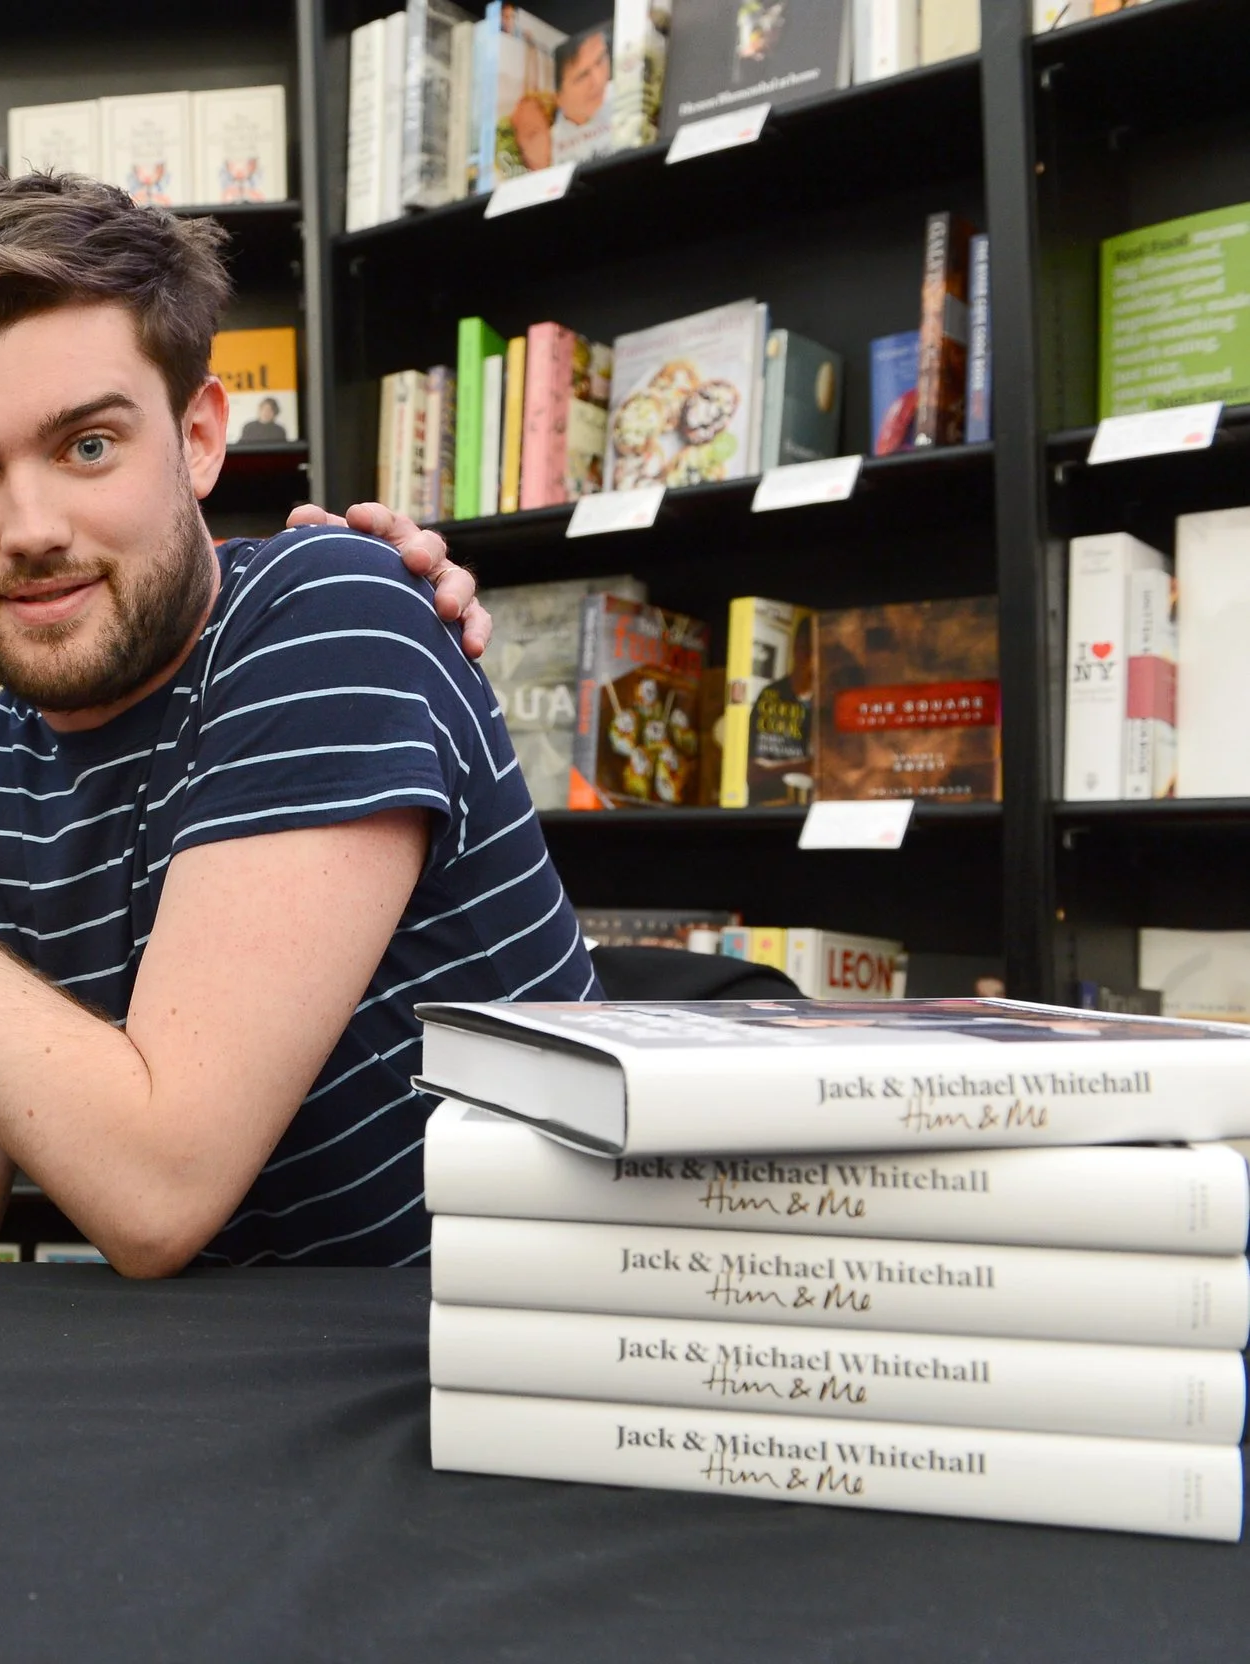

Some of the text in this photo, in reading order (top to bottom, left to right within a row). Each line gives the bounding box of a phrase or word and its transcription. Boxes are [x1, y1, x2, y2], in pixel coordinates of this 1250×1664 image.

[859, 696, 984, 715] THE SQUARE
[828, 948, 897, 995] LEON
[817, 1069, 1152, 1106] Jack & Michael Whitehall
[898, 1095, 1050, 1133] Him & Me
[612, 1157, 992, 1194] Jack & Michael Whitehall
[699, 1178, 868, 1219] Him & Me
[620, 1248, 996, 1289] Jack & Michael Whitehall
[706, 1273, 874, 1313] Him & Me
[616, 1337, 992, 1384] Jack & Michael Whitehall
[701, 1363, 869, 1405] Him & Me
[615, 1425, 987, 1475] Jack & Michael Whitehall
[699, 1453, 865, 1495] Him & Me
